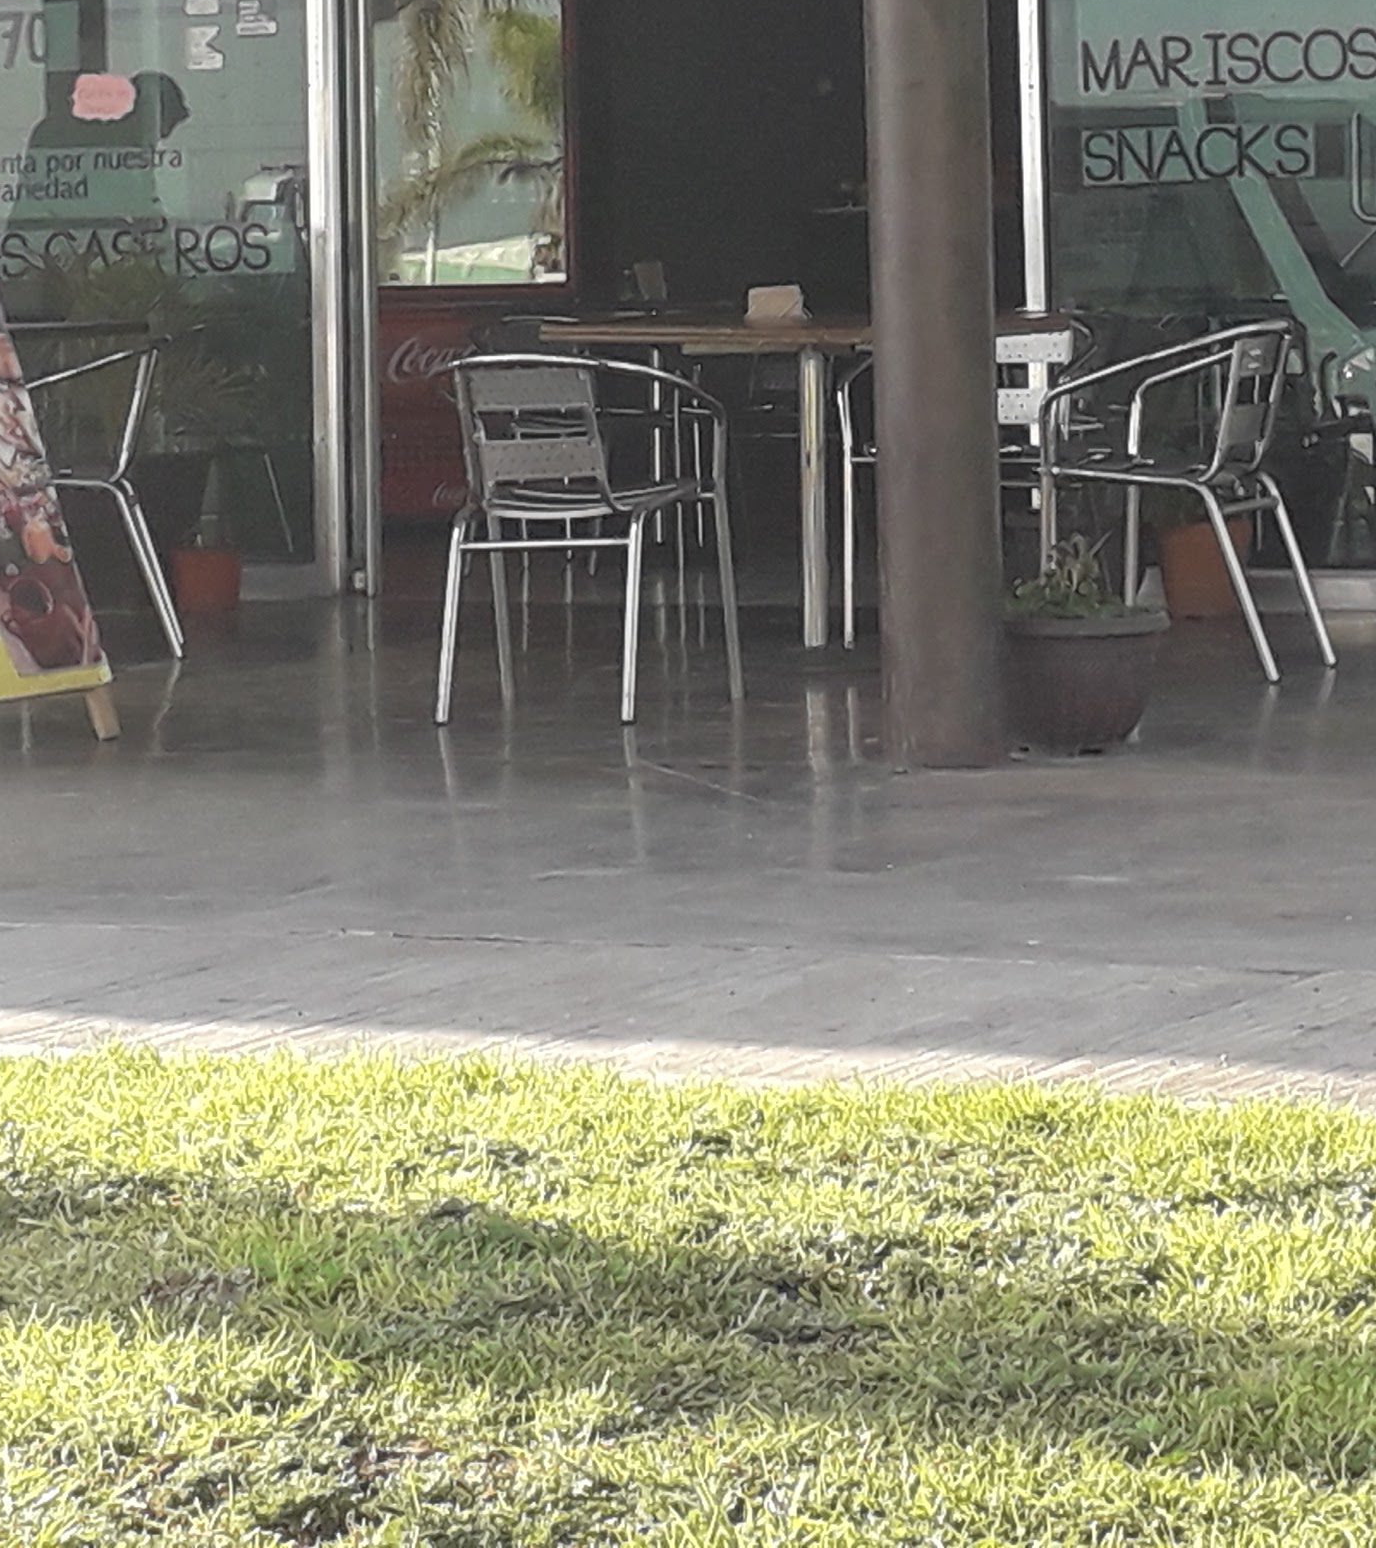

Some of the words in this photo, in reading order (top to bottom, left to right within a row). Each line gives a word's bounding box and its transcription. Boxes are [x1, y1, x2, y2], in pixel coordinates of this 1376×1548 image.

[46, 153, 85, 179] por
[93, 144, 183, 170] nuestra
[1083, 123, 1311, 182] SNACKS
